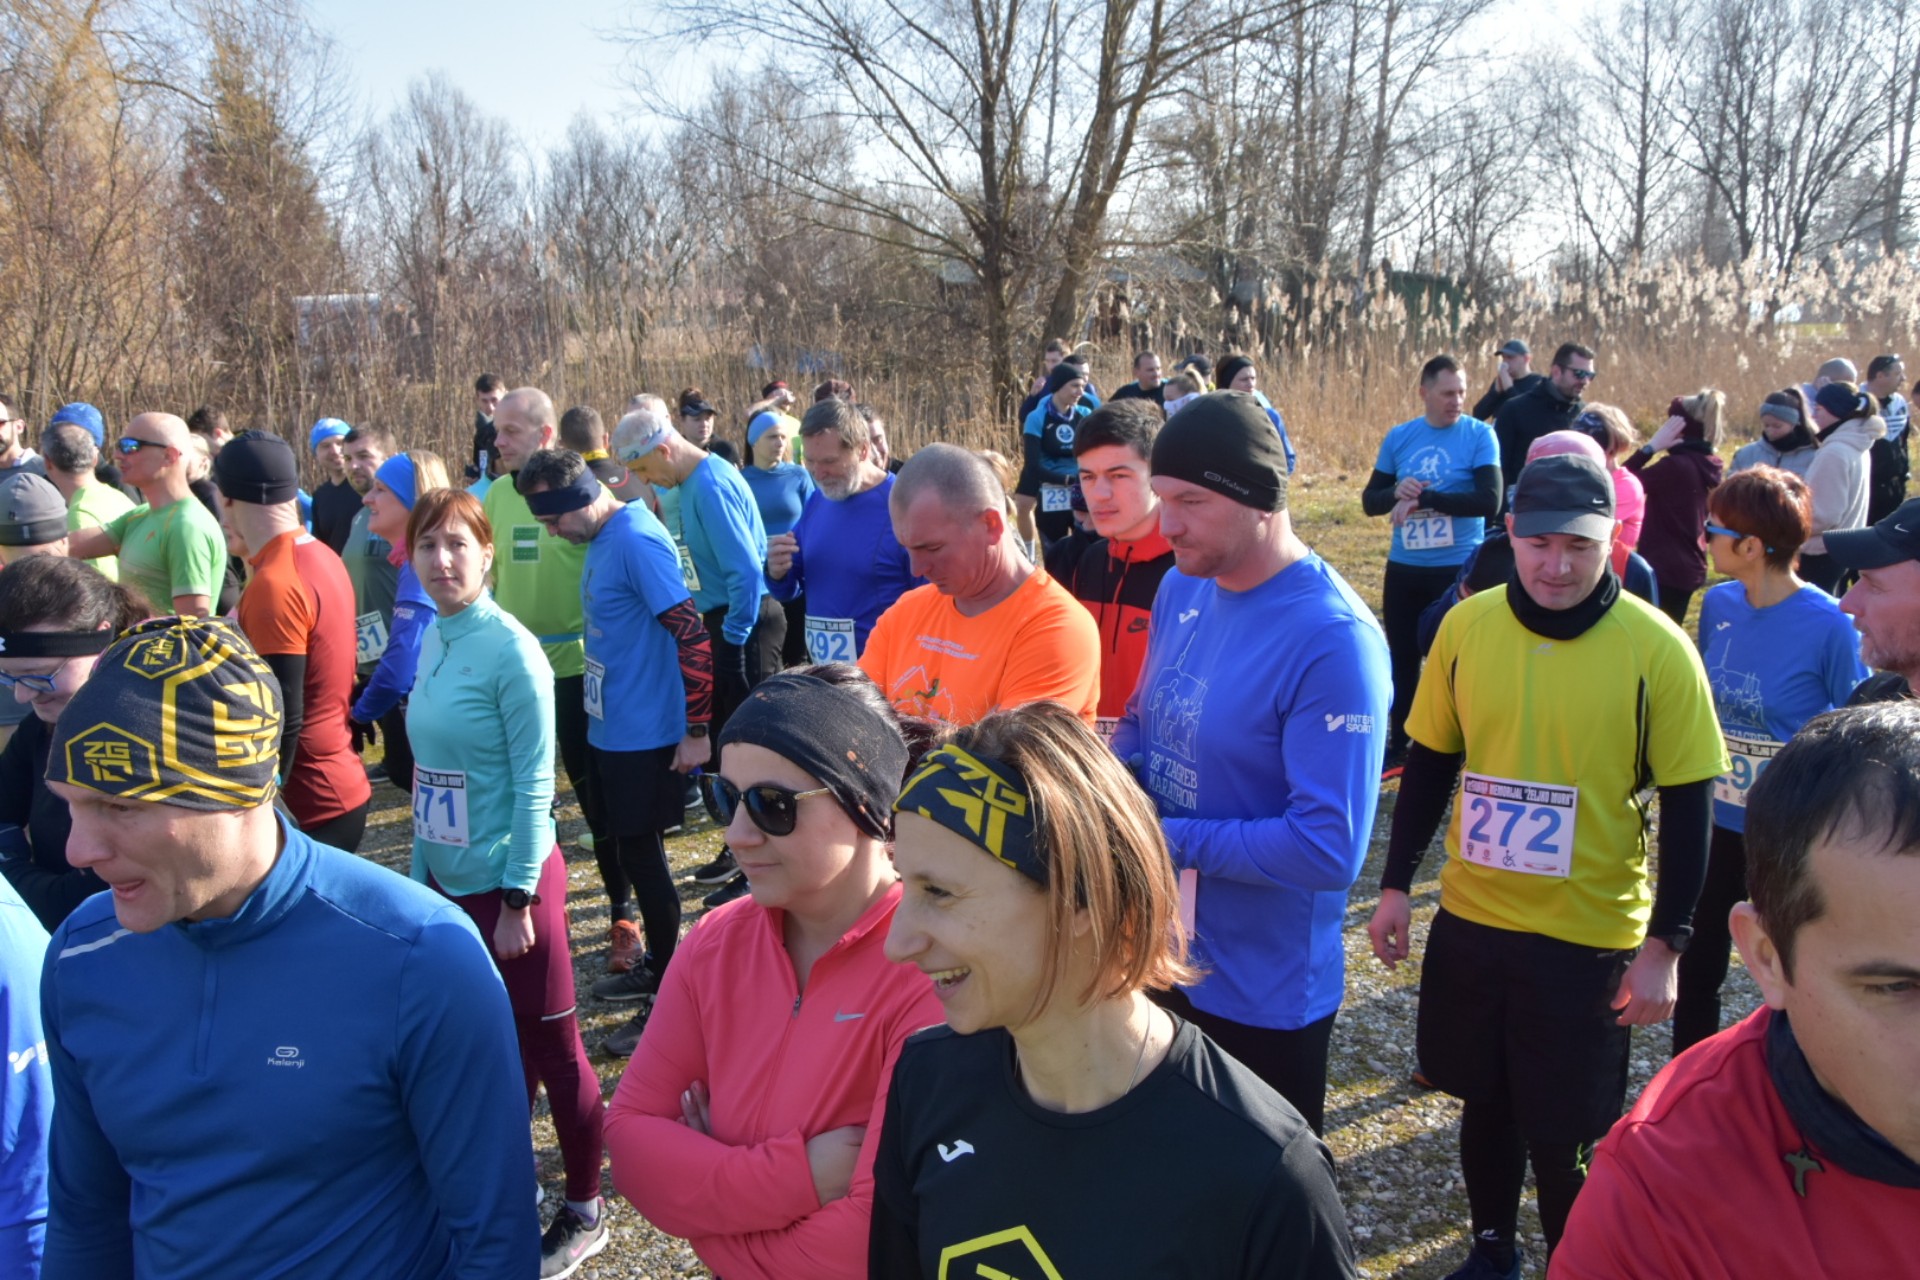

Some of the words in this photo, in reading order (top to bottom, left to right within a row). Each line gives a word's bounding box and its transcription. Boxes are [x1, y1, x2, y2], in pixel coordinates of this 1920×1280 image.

[1406, 518, 1447, 540] 212
[806, 630, 850, 661] 292
[1345, 723, 1372, 735] SPORT
[1346, 713, 1375, 726] INTER
[1164, 757, 1198, 789] ZAGREB
[1148, 770, 1198, 811] MARATHON
[1468, 797, 1562, 854] 272
[267, 1057, 305, 1069] Kalenji
